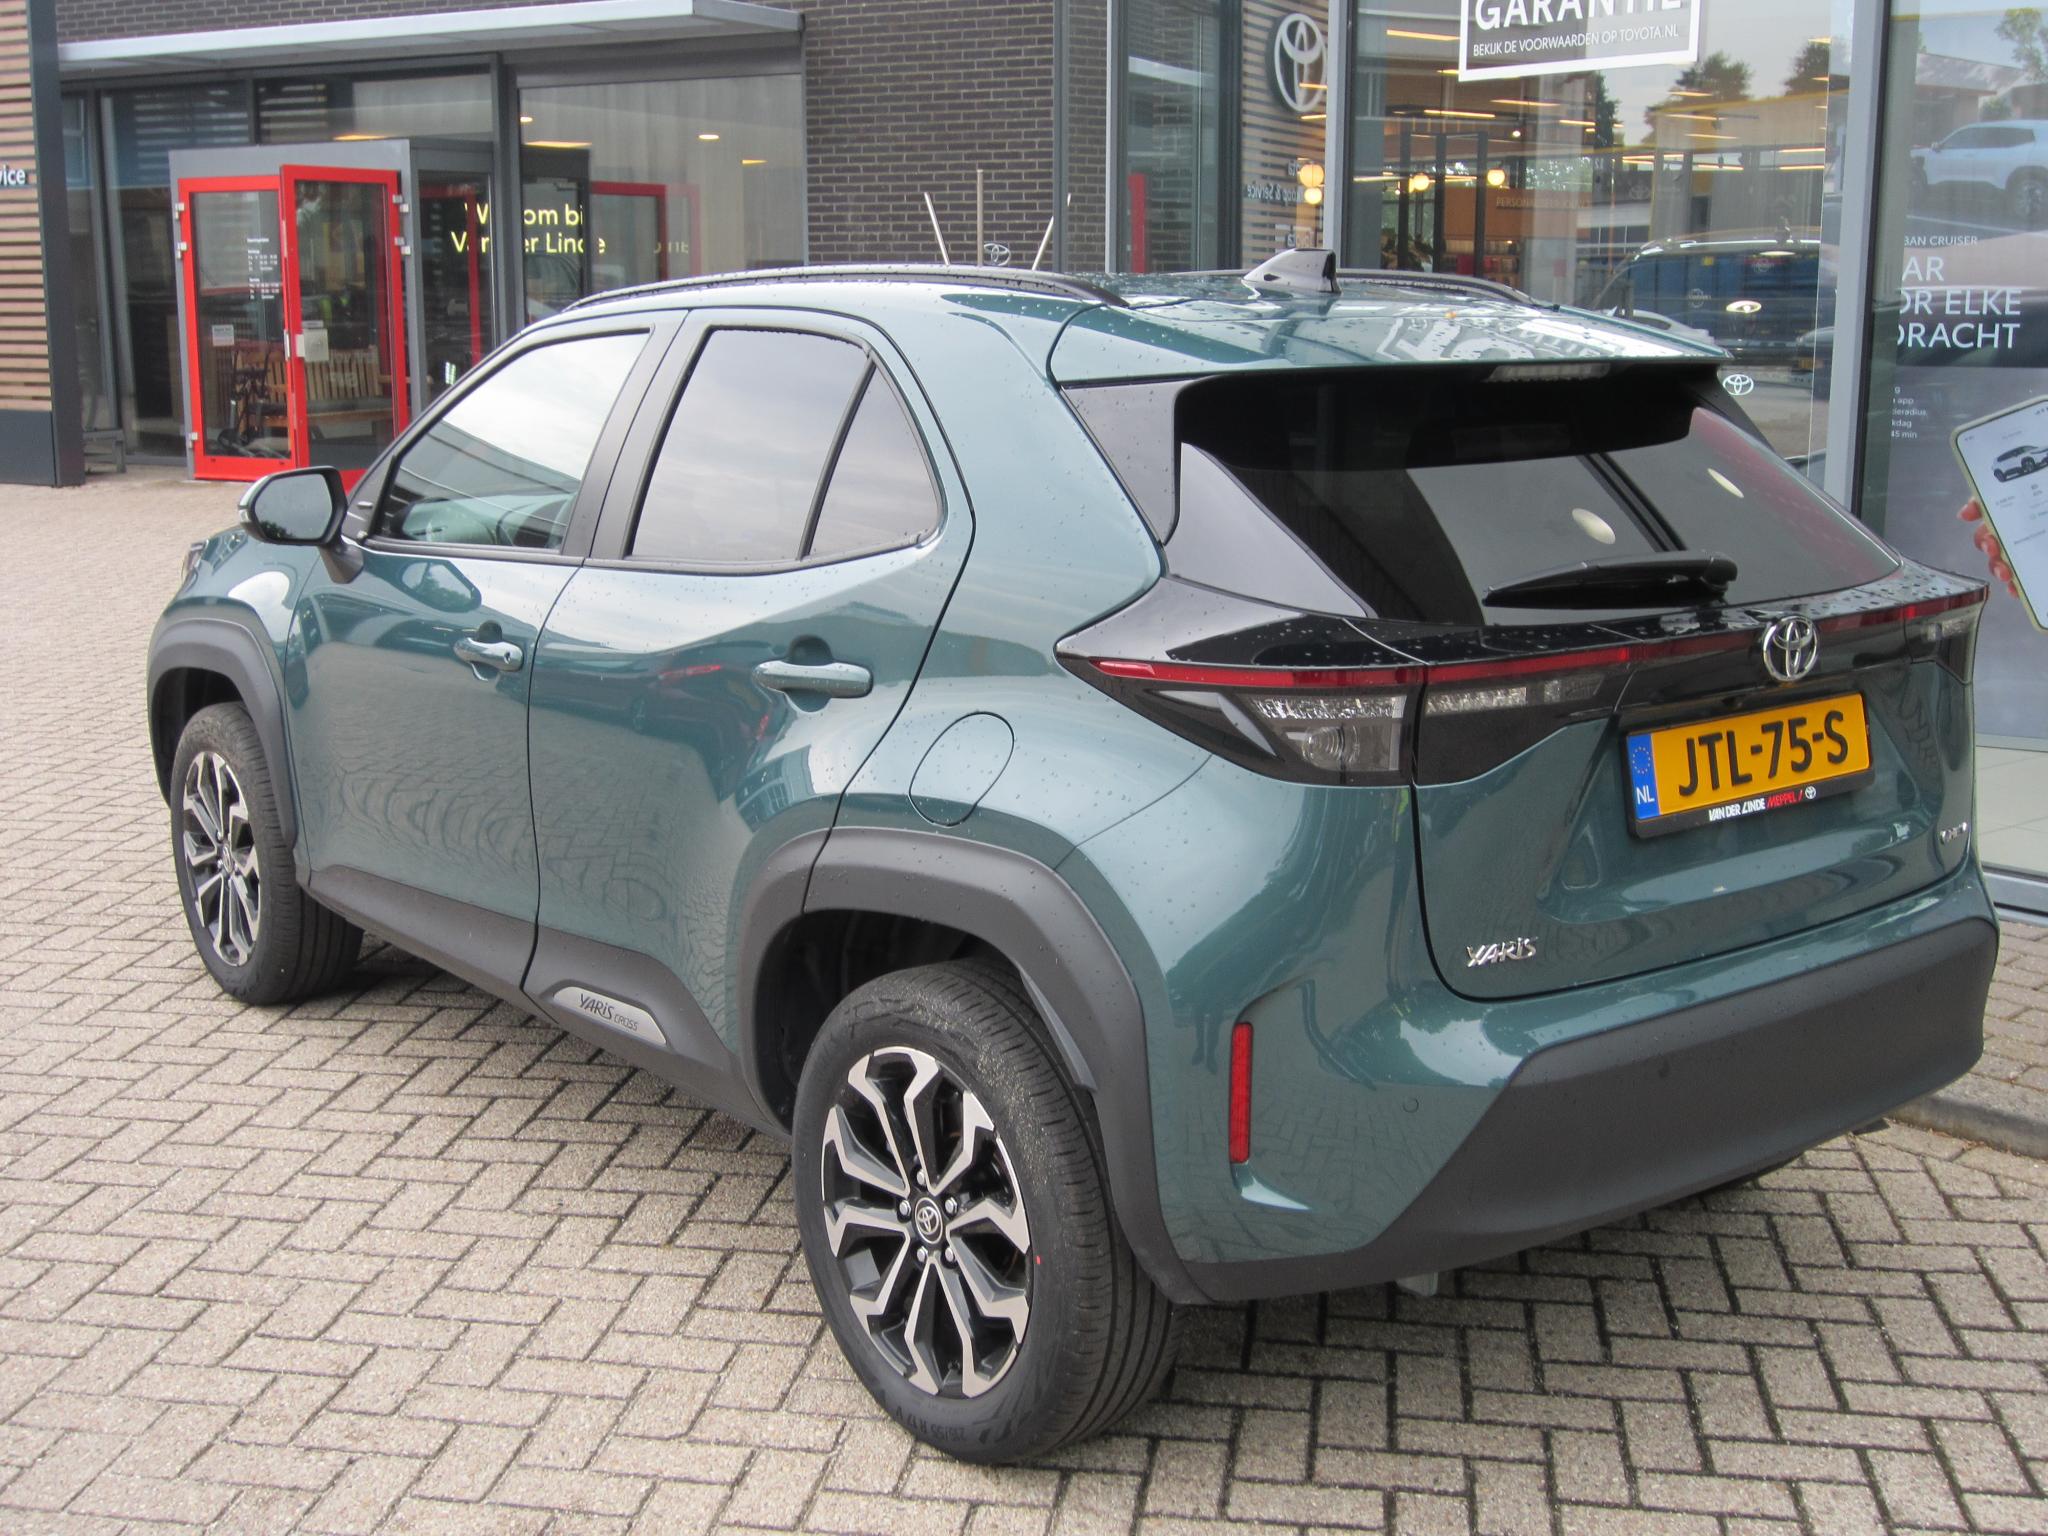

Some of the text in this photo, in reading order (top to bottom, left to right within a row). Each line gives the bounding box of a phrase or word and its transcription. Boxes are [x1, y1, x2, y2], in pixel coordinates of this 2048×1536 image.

[1473, 23, 1679, 57] BEKIJK DE VOORWAARDEN OP TOYOTA.NL
[0, 163, 26, 187] ice
[1929, 235, 1978, 246] CRUISER
[1944, 288, 2022, 315] ELKE
[1678, 709, 1849, 798] JTL-75-S
[1636, 786, 1655, 805] NL
[1708, 792, 1797, 822] VAN DER LINDE MEPPEL
